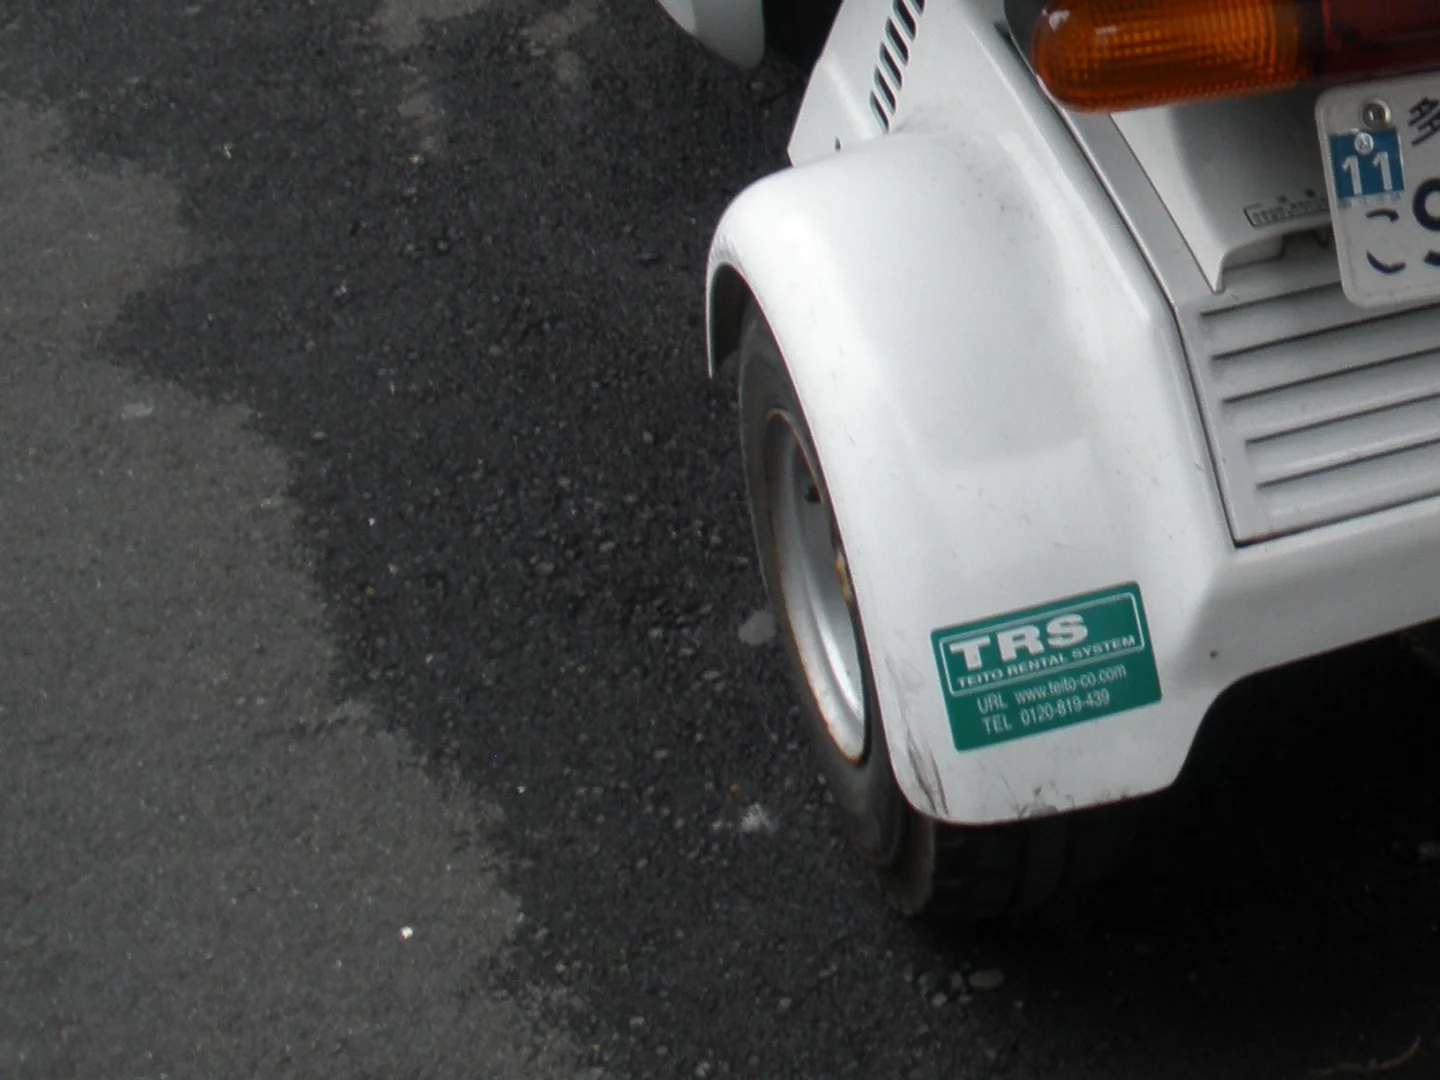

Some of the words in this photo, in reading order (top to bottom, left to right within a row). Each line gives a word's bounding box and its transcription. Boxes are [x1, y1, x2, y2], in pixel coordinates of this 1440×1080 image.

[1341, 151, 1393, 195] 11
[1366, 208, 1407, 273] こ
[949, 613, 1089, 671] TRS
[957, 668, 1004, 688] TEITO
[1007, 653, 1067, 677] RENTAL
[1072, 634, 1136, 660] SYSTEM
[976, 692, 1009, 715] URL
[981, 713, 1013, 735] TEL
